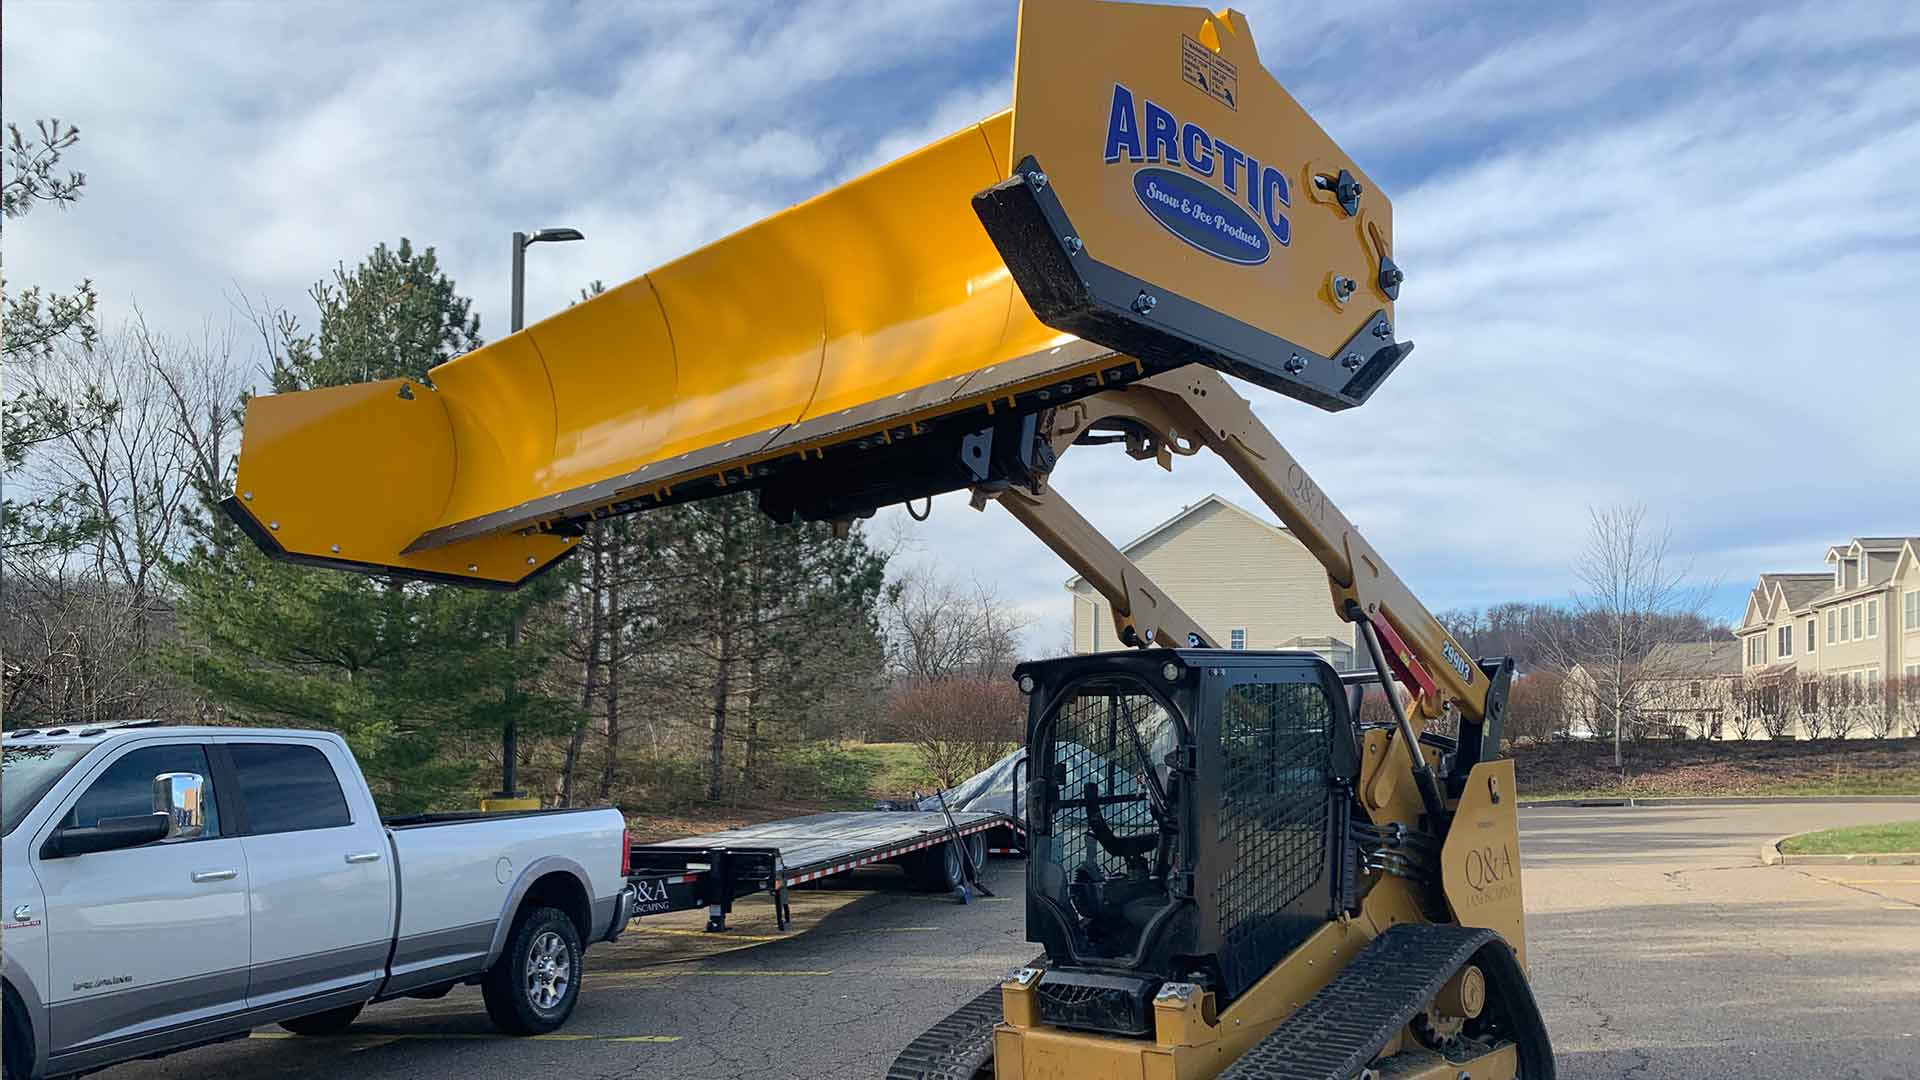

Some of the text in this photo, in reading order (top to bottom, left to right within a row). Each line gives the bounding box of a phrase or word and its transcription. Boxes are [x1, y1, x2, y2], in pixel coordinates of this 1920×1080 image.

[1104, 82, 1291, 247] ARCTIC
[1146, 182, 1261, 249] Snow & Ice Products
[1465, 843, 1513, 892] Q&A
